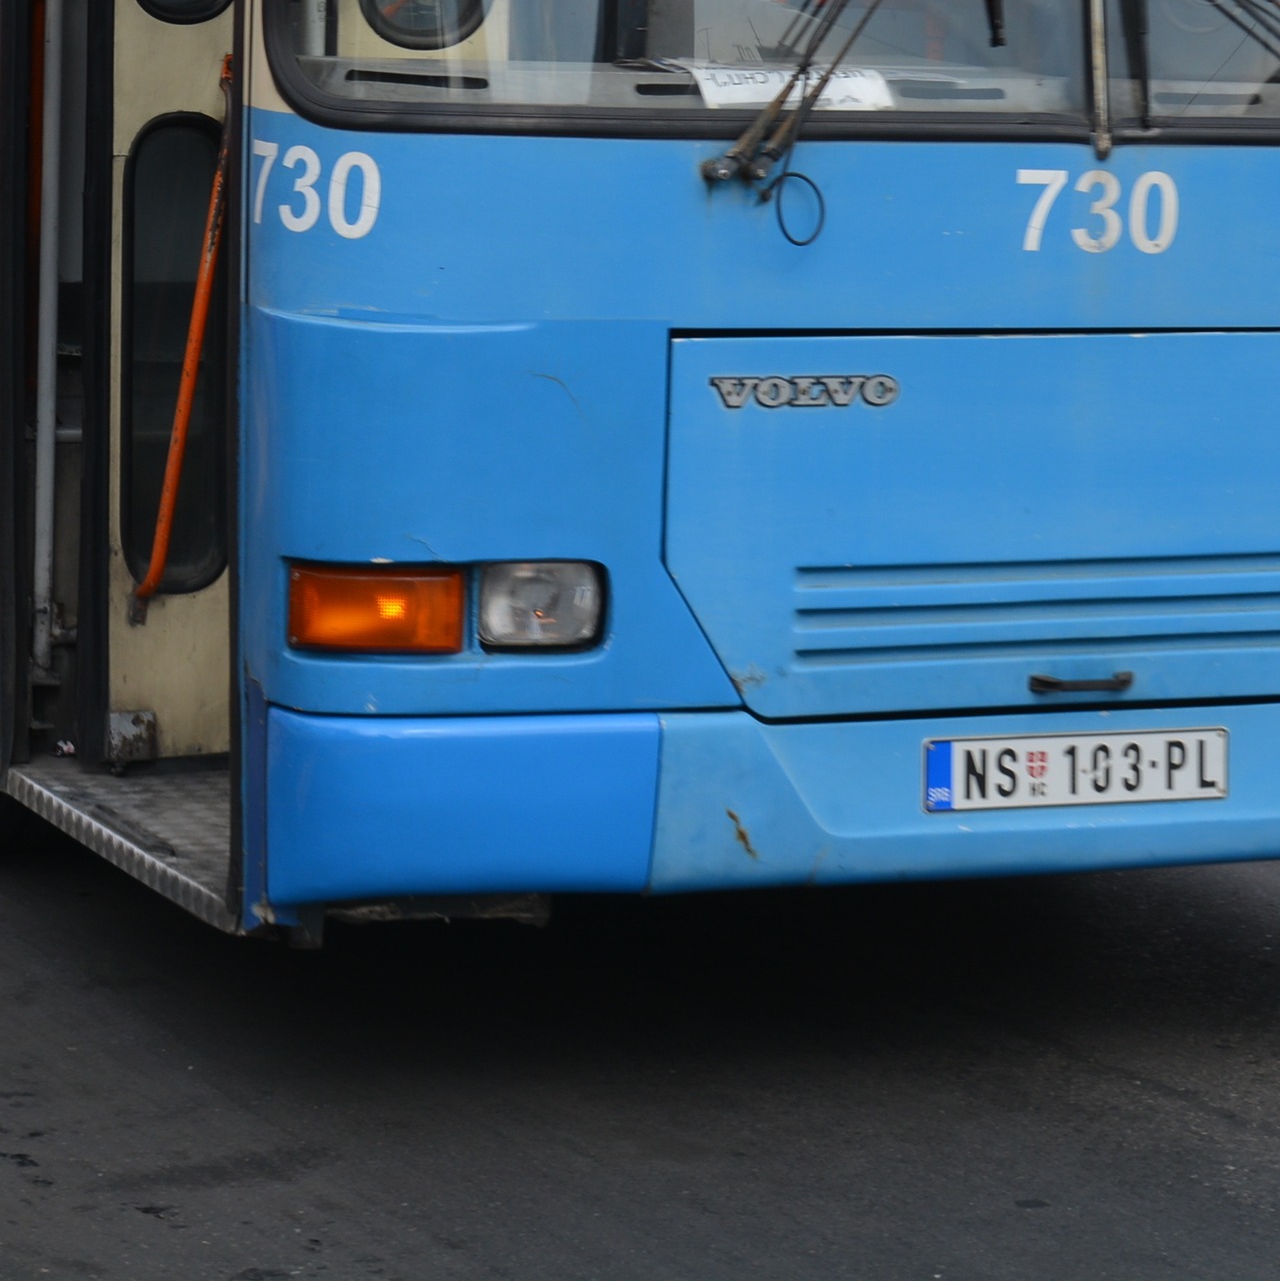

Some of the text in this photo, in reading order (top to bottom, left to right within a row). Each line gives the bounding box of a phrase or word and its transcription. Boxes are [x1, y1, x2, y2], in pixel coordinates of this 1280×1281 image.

[252, 139, 382, 240] 730
[1015, 168, 1180, 255] 730
[709, 374, 901, 409] VOLVO
[964, 747, 1019, 801] NS
